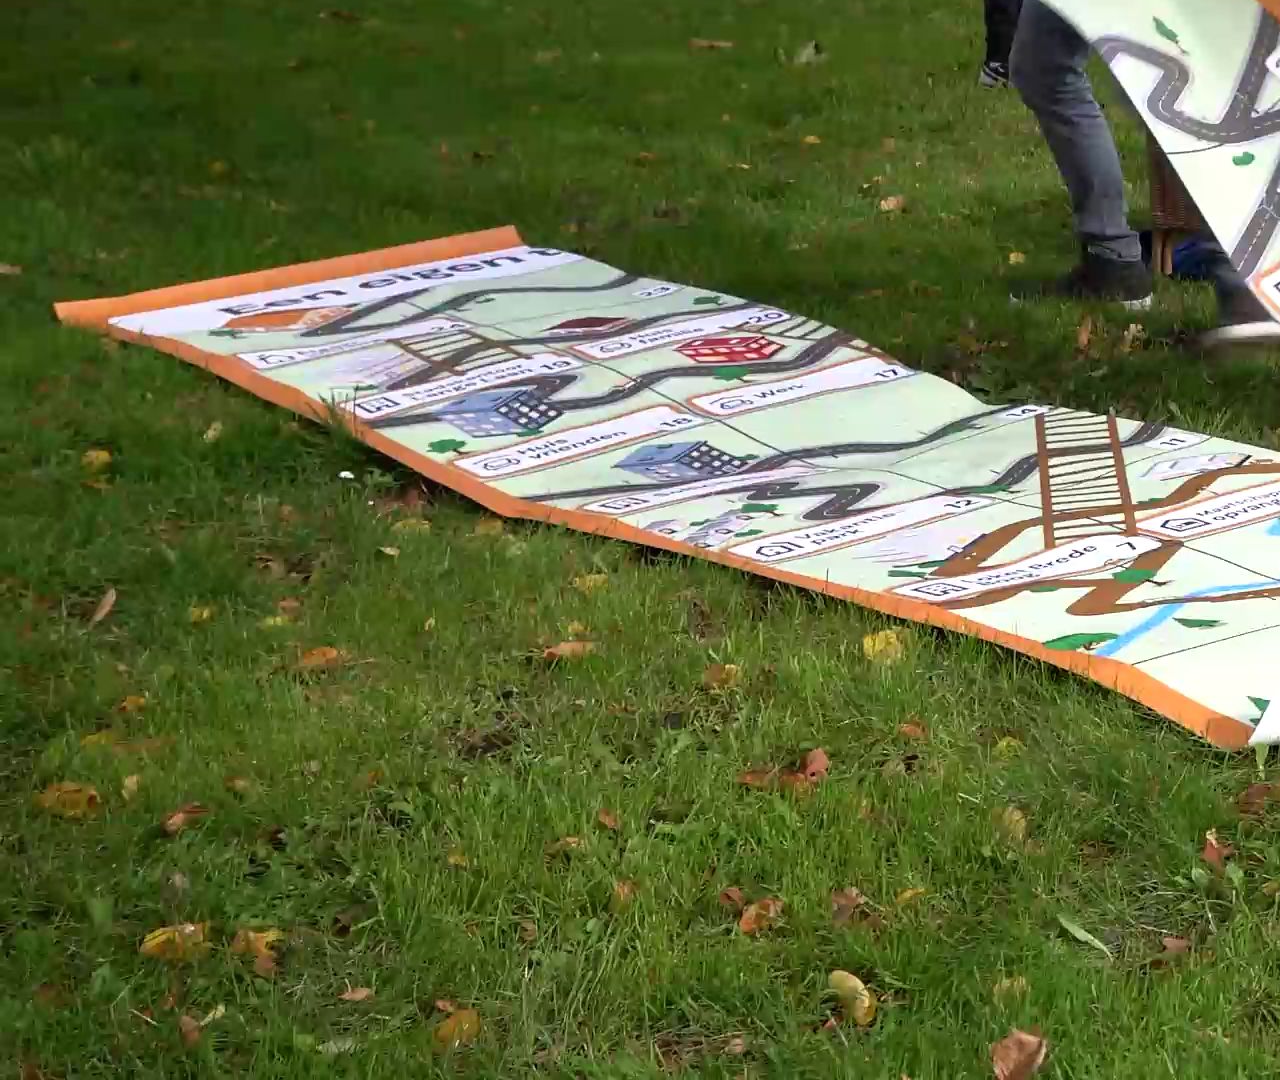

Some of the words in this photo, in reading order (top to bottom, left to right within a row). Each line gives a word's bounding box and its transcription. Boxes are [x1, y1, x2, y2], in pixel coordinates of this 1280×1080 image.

[218, 288, 347, 316] Een
[358, 253, 525, 289] eigen
[748, 311, 783, 325] 20
[541, 360, 571, 371] 19
[874, 368, 899, 379] 17
[753, 383, 806, 399] Werk
[661, 416, 694, 428] 18
[518, 437, 569, 455] Huis
[528, 430, 628, 460] vrienden
[1161, 437, 1186, 447] 11
[944, 498, 981, 509] 12
[808, 528, 865, 546] park
[1116, 541, 1137, 551] 7
